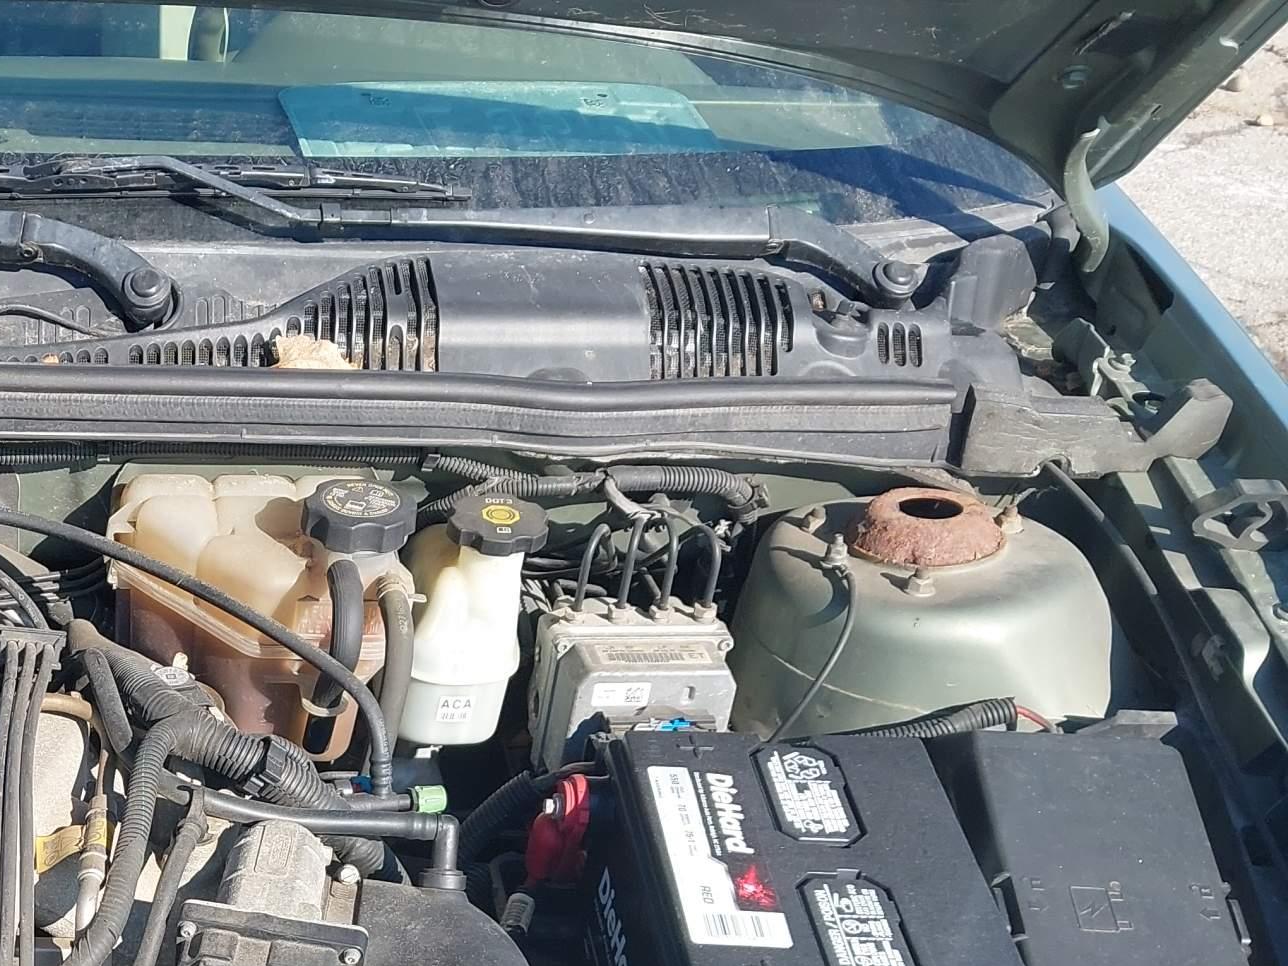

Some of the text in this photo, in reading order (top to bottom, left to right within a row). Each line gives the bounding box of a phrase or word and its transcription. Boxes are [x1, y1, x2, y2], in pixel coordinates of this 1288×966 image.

[706, 772, 755, 854] DieHard
[814, 889, 836, 921] POISON
[828, 929, 852, 966] DANGER
